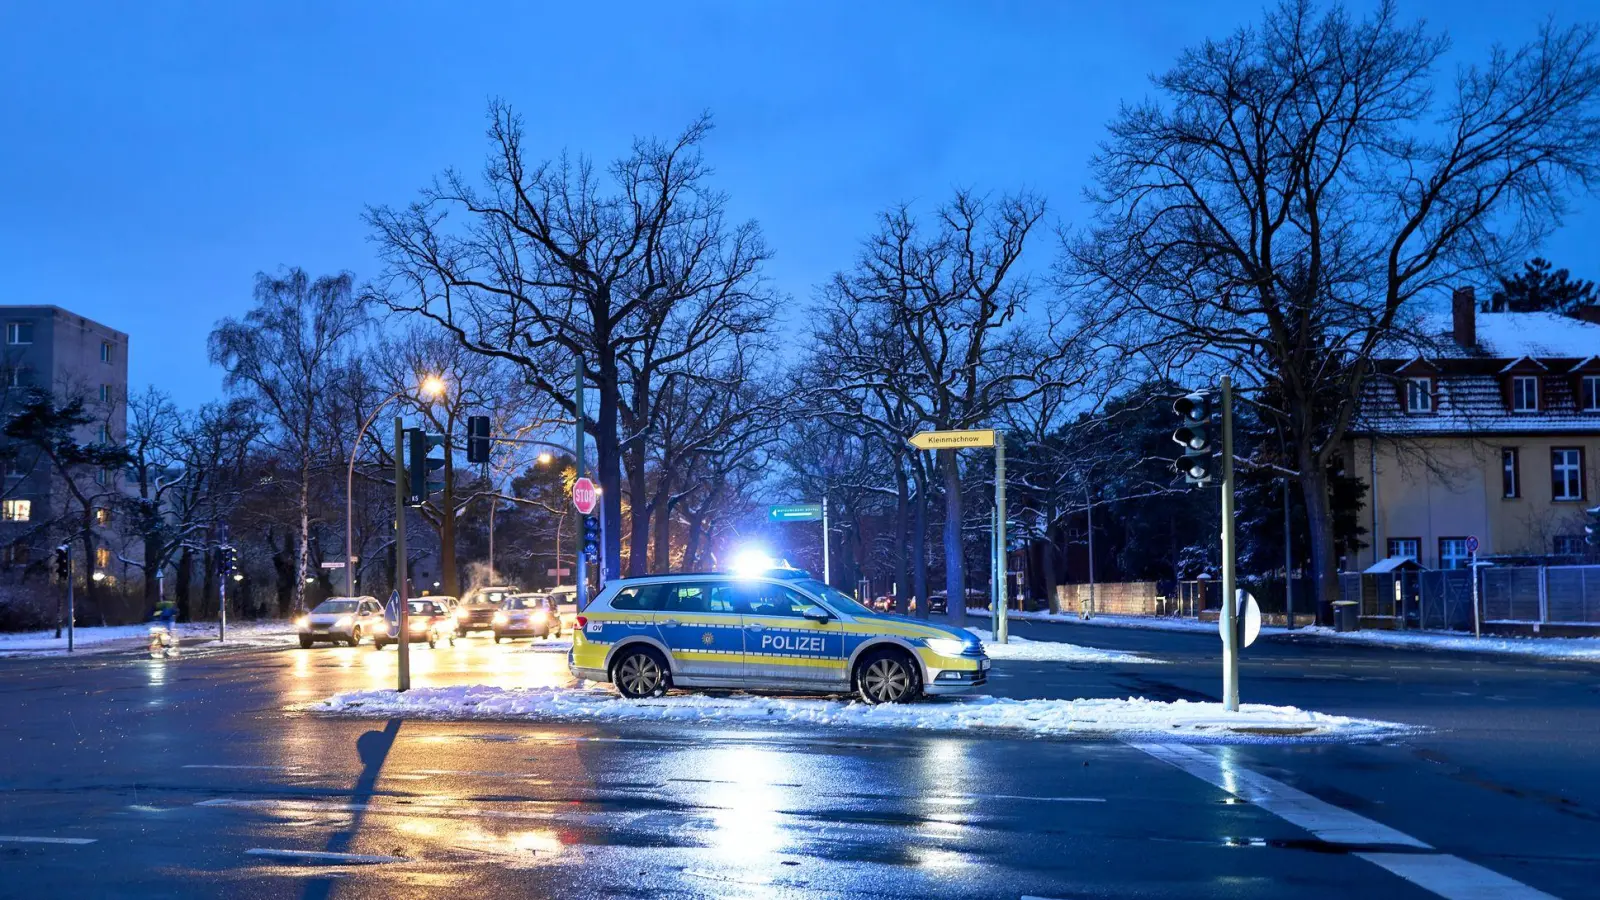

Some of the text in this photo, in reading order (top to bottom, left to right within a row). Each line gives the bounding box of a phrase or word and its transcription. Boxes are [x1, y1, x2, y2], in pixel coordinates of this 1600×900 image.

[928, 436, 979, 444] Kleinmachnow
[575, 489, 594, 503] STOP
[761, 635, 825, 651] POLIZEI
